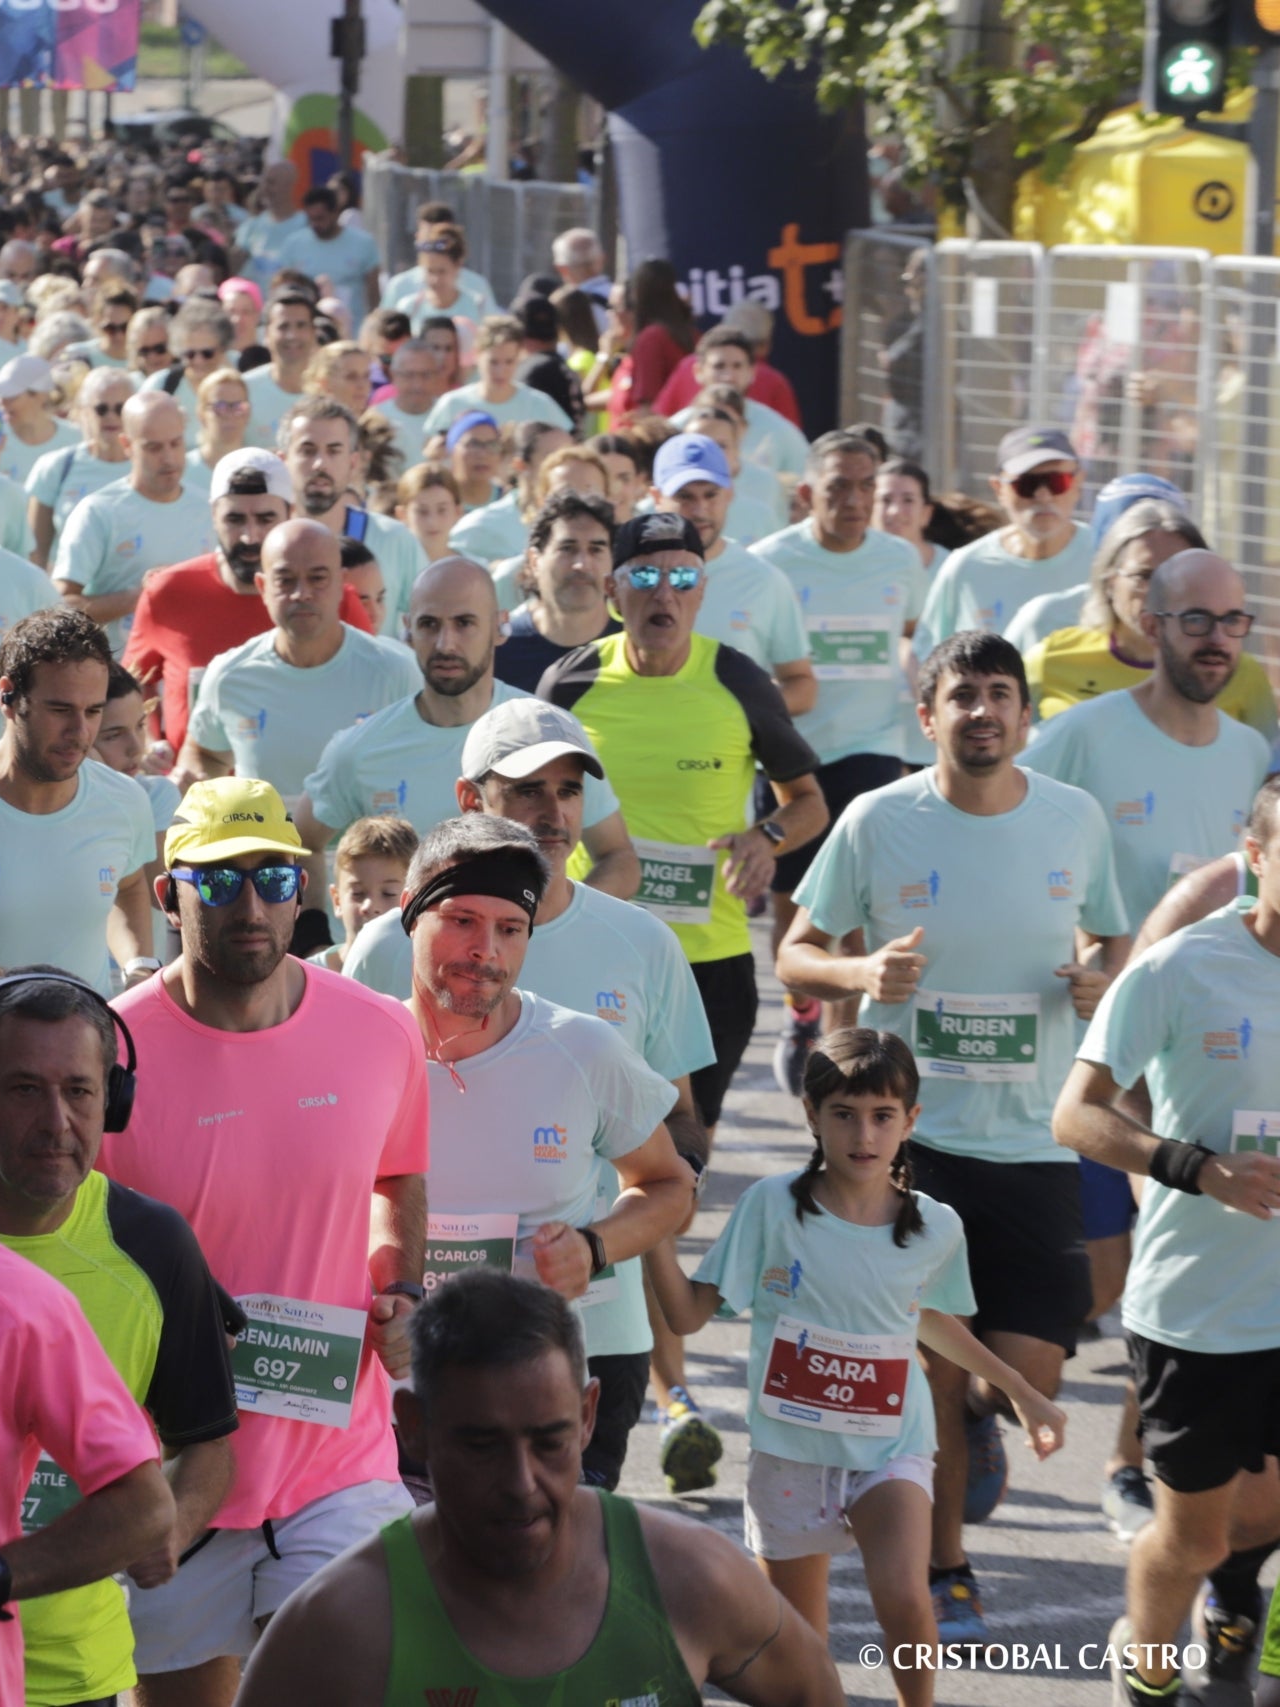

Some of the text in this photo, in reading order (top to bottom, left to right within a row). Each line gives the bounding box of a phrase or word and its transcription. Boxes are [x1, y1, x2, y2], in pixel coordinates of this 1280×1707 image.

[677, 759, 710, 771] CIRSA
[222, 812, 255, 824] CIRSA
[642, 862, 695, 883] NGEL
[643, 882, 677, 898] 748
[941, 1016, 1016, 1036] RUBEN
[958, 1039, 997, 1055] 806
[298, 1097, 327, 1109] CIRSA
[434, 1249, 487, 1262] CARLOS
[234, 1328, 330, 1357] BENJAMIN
[253, 1356, 301, 1381] 697
[808, 1354, 877, 1383] SARA
[823, 1384, 855, 1403] 40
[31, 1471, 68, 1487] RTLE
